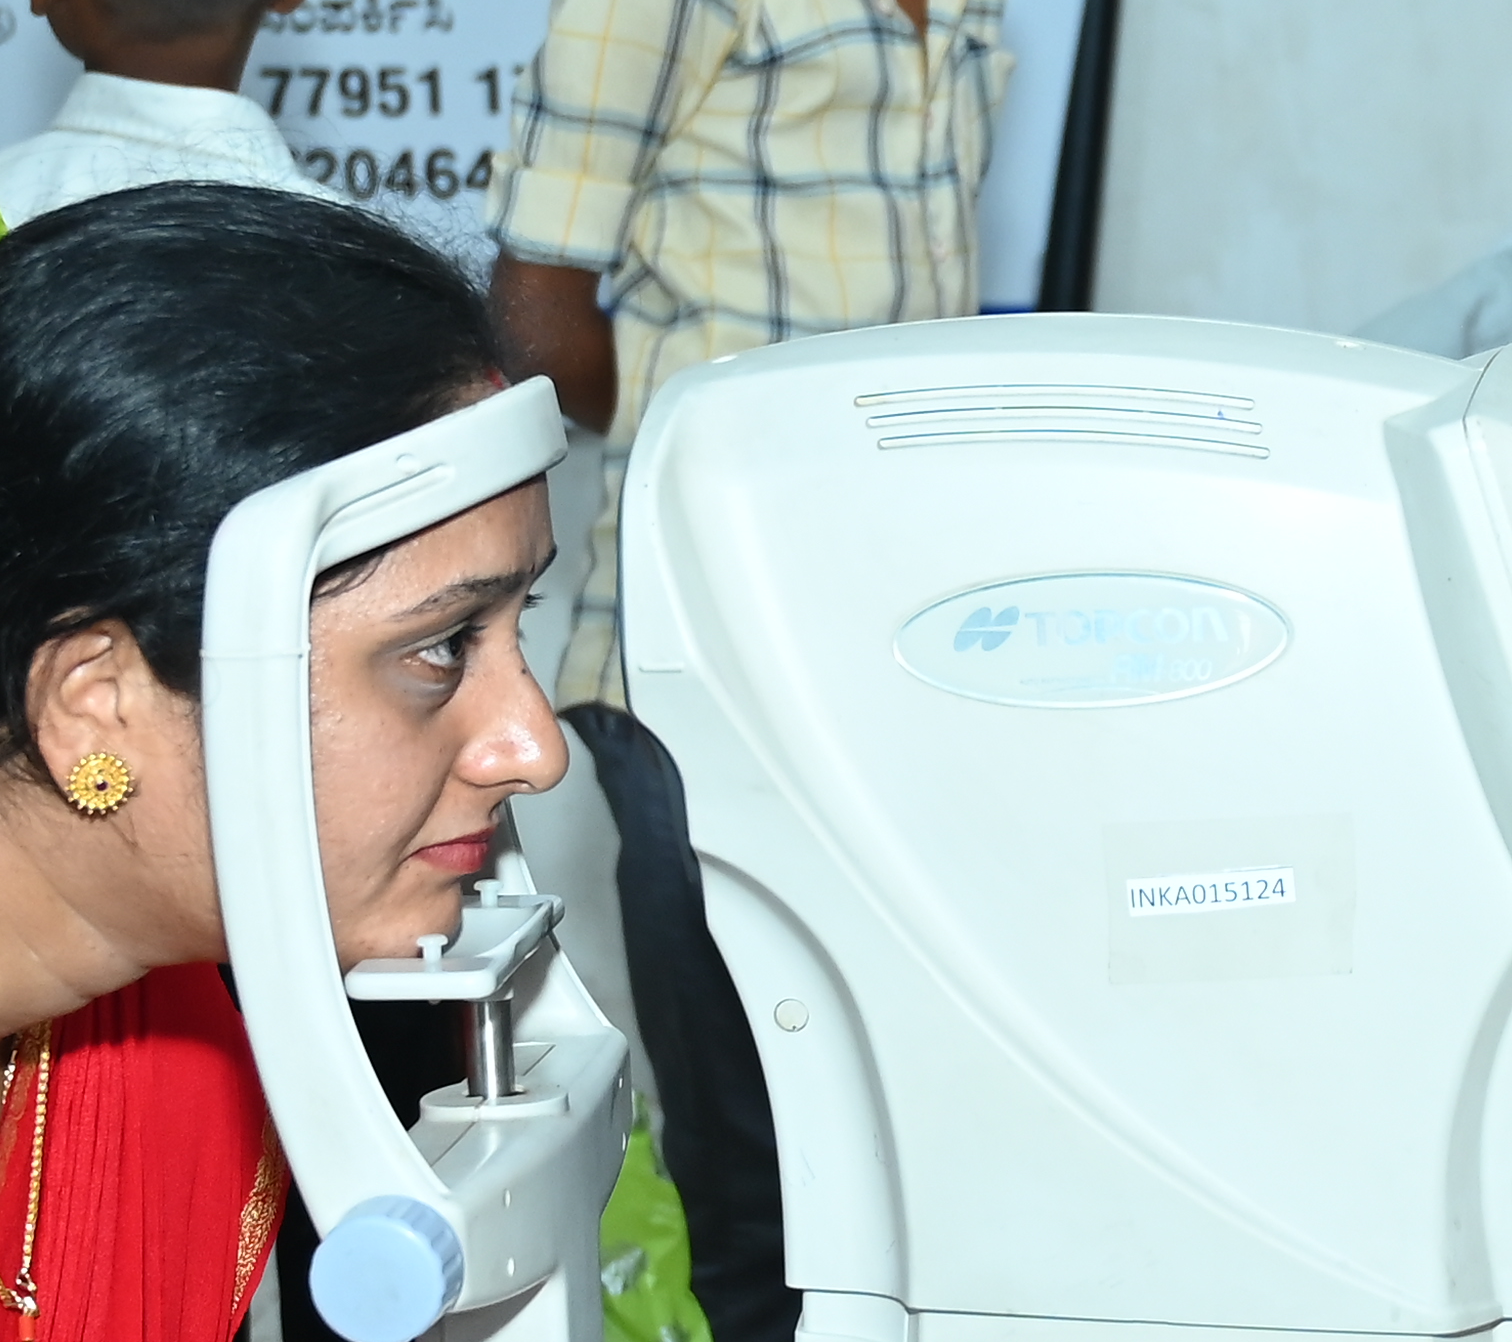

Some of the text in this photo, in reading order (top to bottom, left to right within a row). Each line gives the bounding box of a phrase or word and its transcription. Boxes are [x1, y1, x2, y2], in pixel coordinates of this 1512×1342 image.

[259, 64, 524, 118] 77951 1
[291, 147, 496, 200] 20464
[1025, 606, 1228, 647] TOPCON
[1131, 878, 1286, 908] INKA015124
